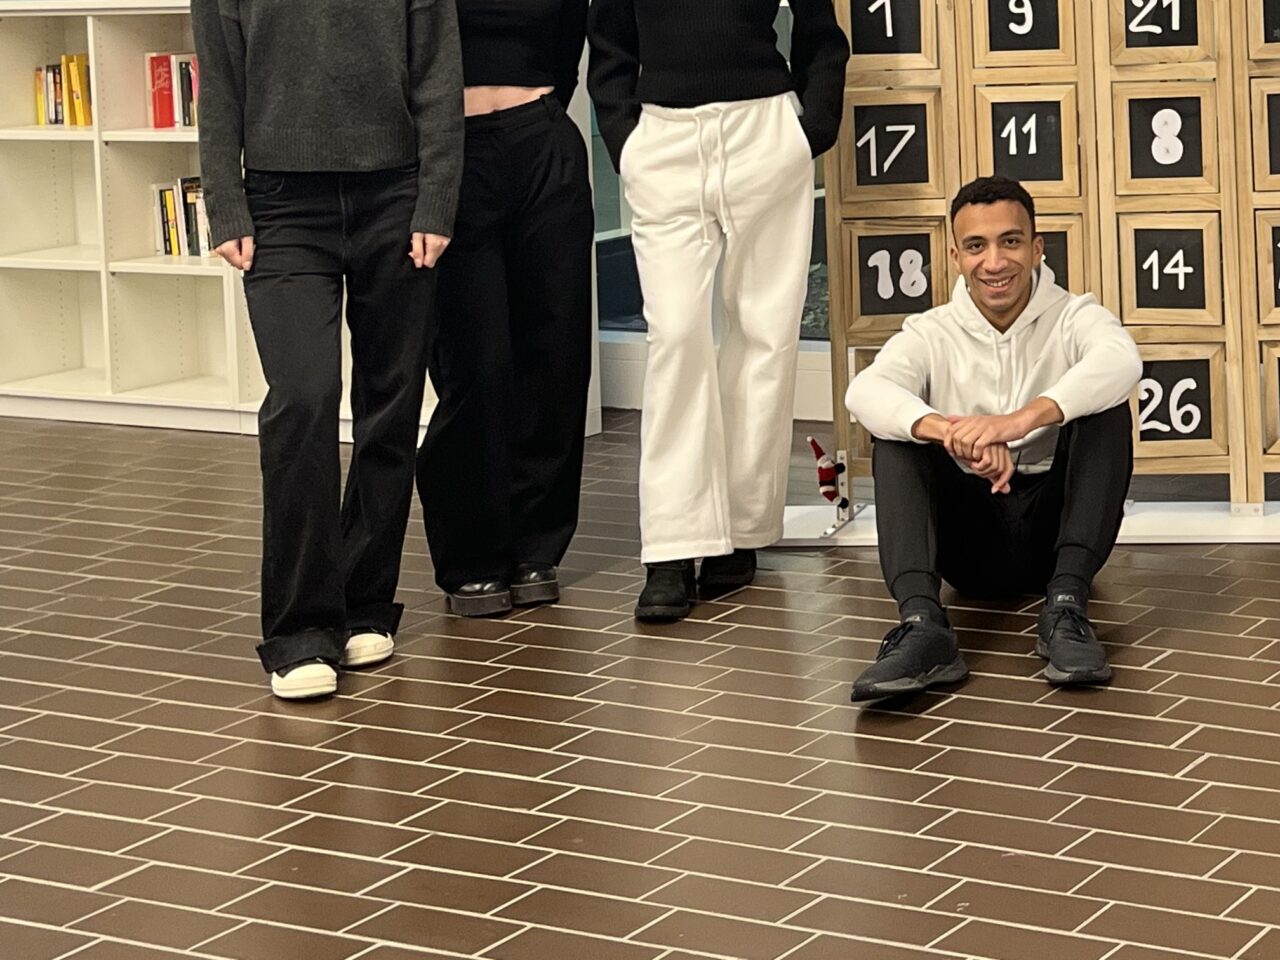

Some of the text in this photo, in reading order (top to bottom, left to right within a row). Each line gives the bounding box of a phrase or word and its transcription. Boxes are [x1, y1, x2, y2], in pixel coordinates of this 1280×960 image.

[856, 124, 916, 177] 17
[1000, 113, 1037, 155] 11
[1151, 108, 1184, 165] 8
[867, 249, 928, 300] 18
[1142, 248, 1194, 291] 14
[1138, 377, 1201, 434] 26
